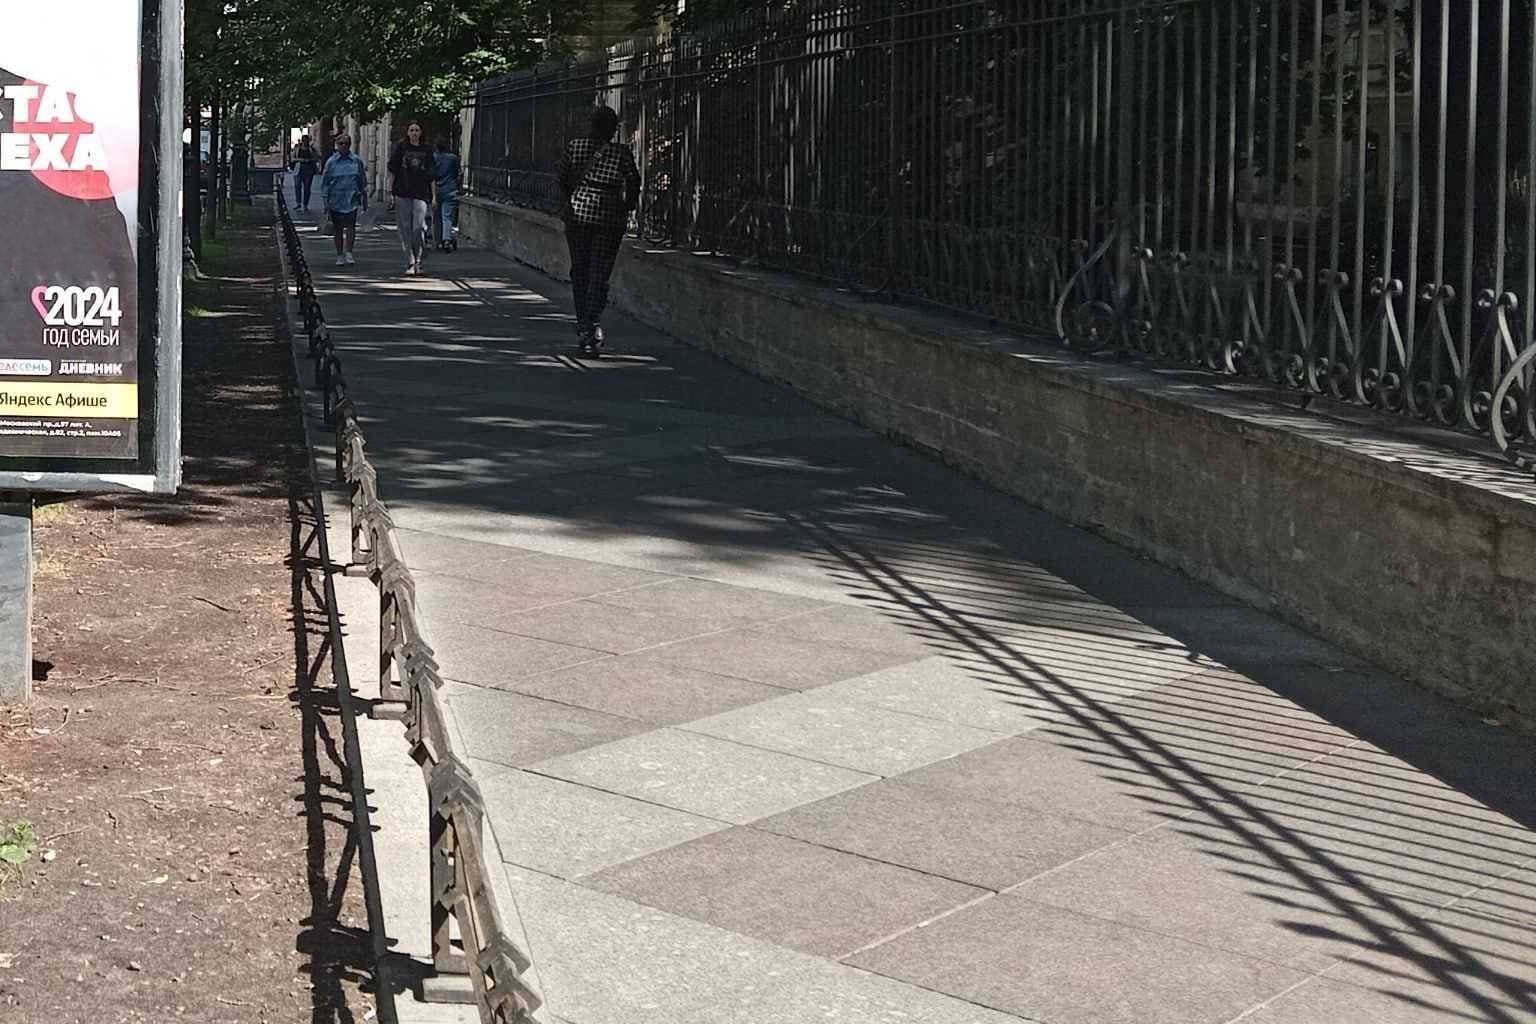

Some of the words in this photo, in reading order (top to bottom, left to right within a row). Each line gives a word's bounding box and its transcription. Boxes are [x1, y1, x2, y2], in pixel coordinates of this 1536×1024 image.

[43, 286, 122, 326] 2024
[44, 328, 69, 348] ГОД
[58, 363, 123, 375] ДНЕВНИК
[0, 393, 52, 407] Яндекс
[56, 393, 107, 408] Афише
